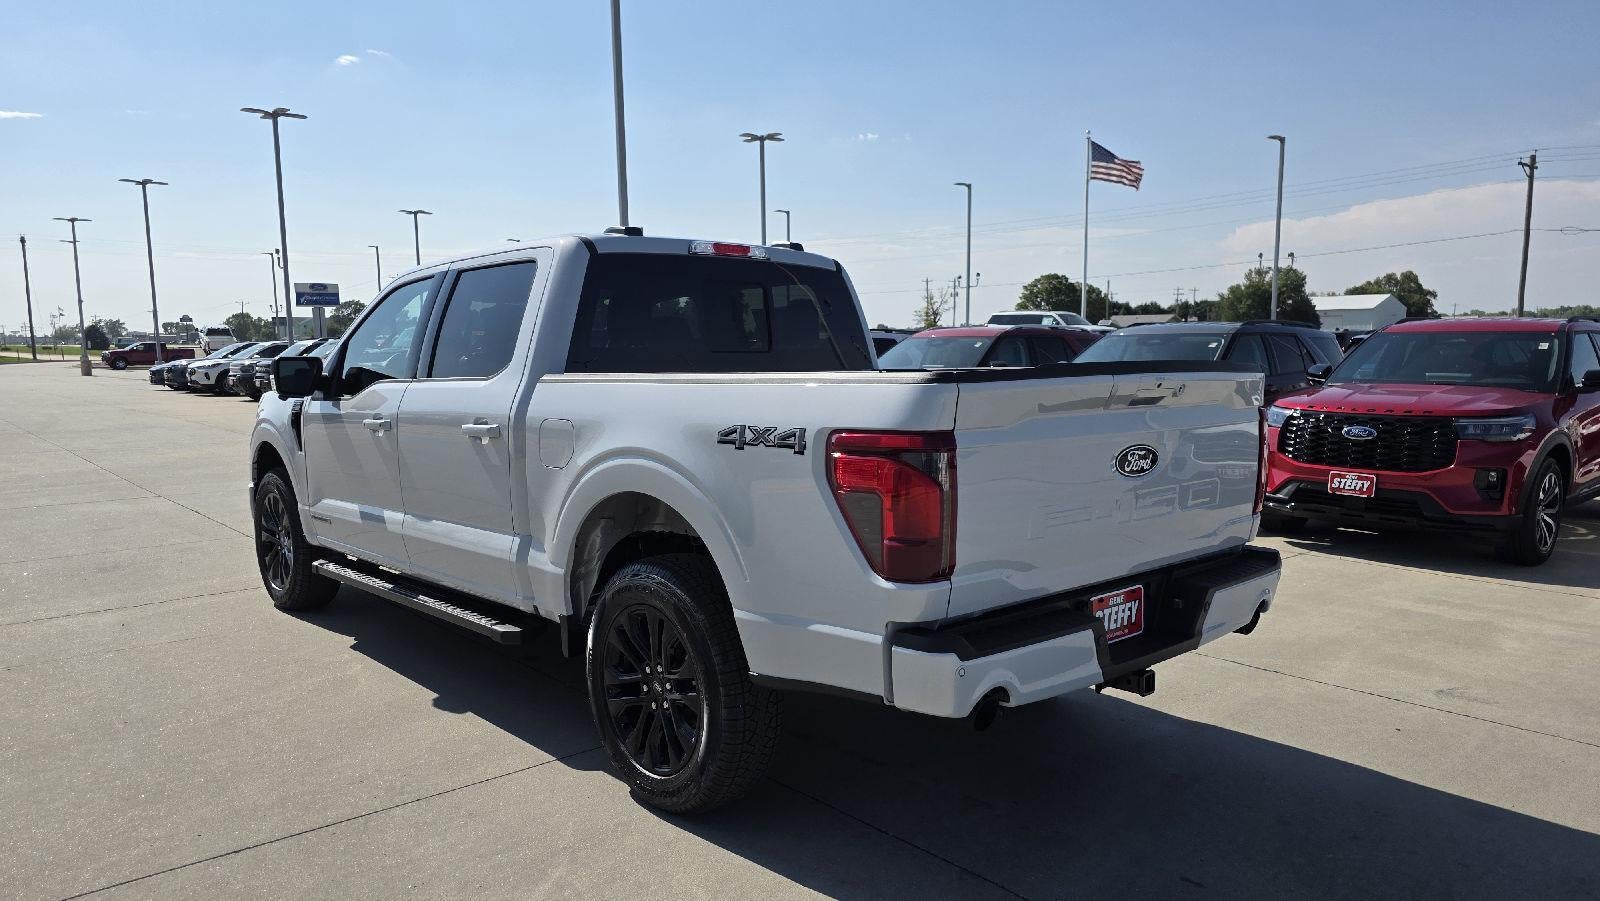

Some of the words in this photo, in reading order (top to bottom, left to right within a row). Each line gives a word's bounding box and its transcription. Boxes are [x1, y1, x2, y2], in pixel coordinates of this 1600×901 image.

[1124, 450, 1153, 471] Ford
[1331, 477, 1371, 492] STEFFY
[1109, 594, 1125, 606] GENE
